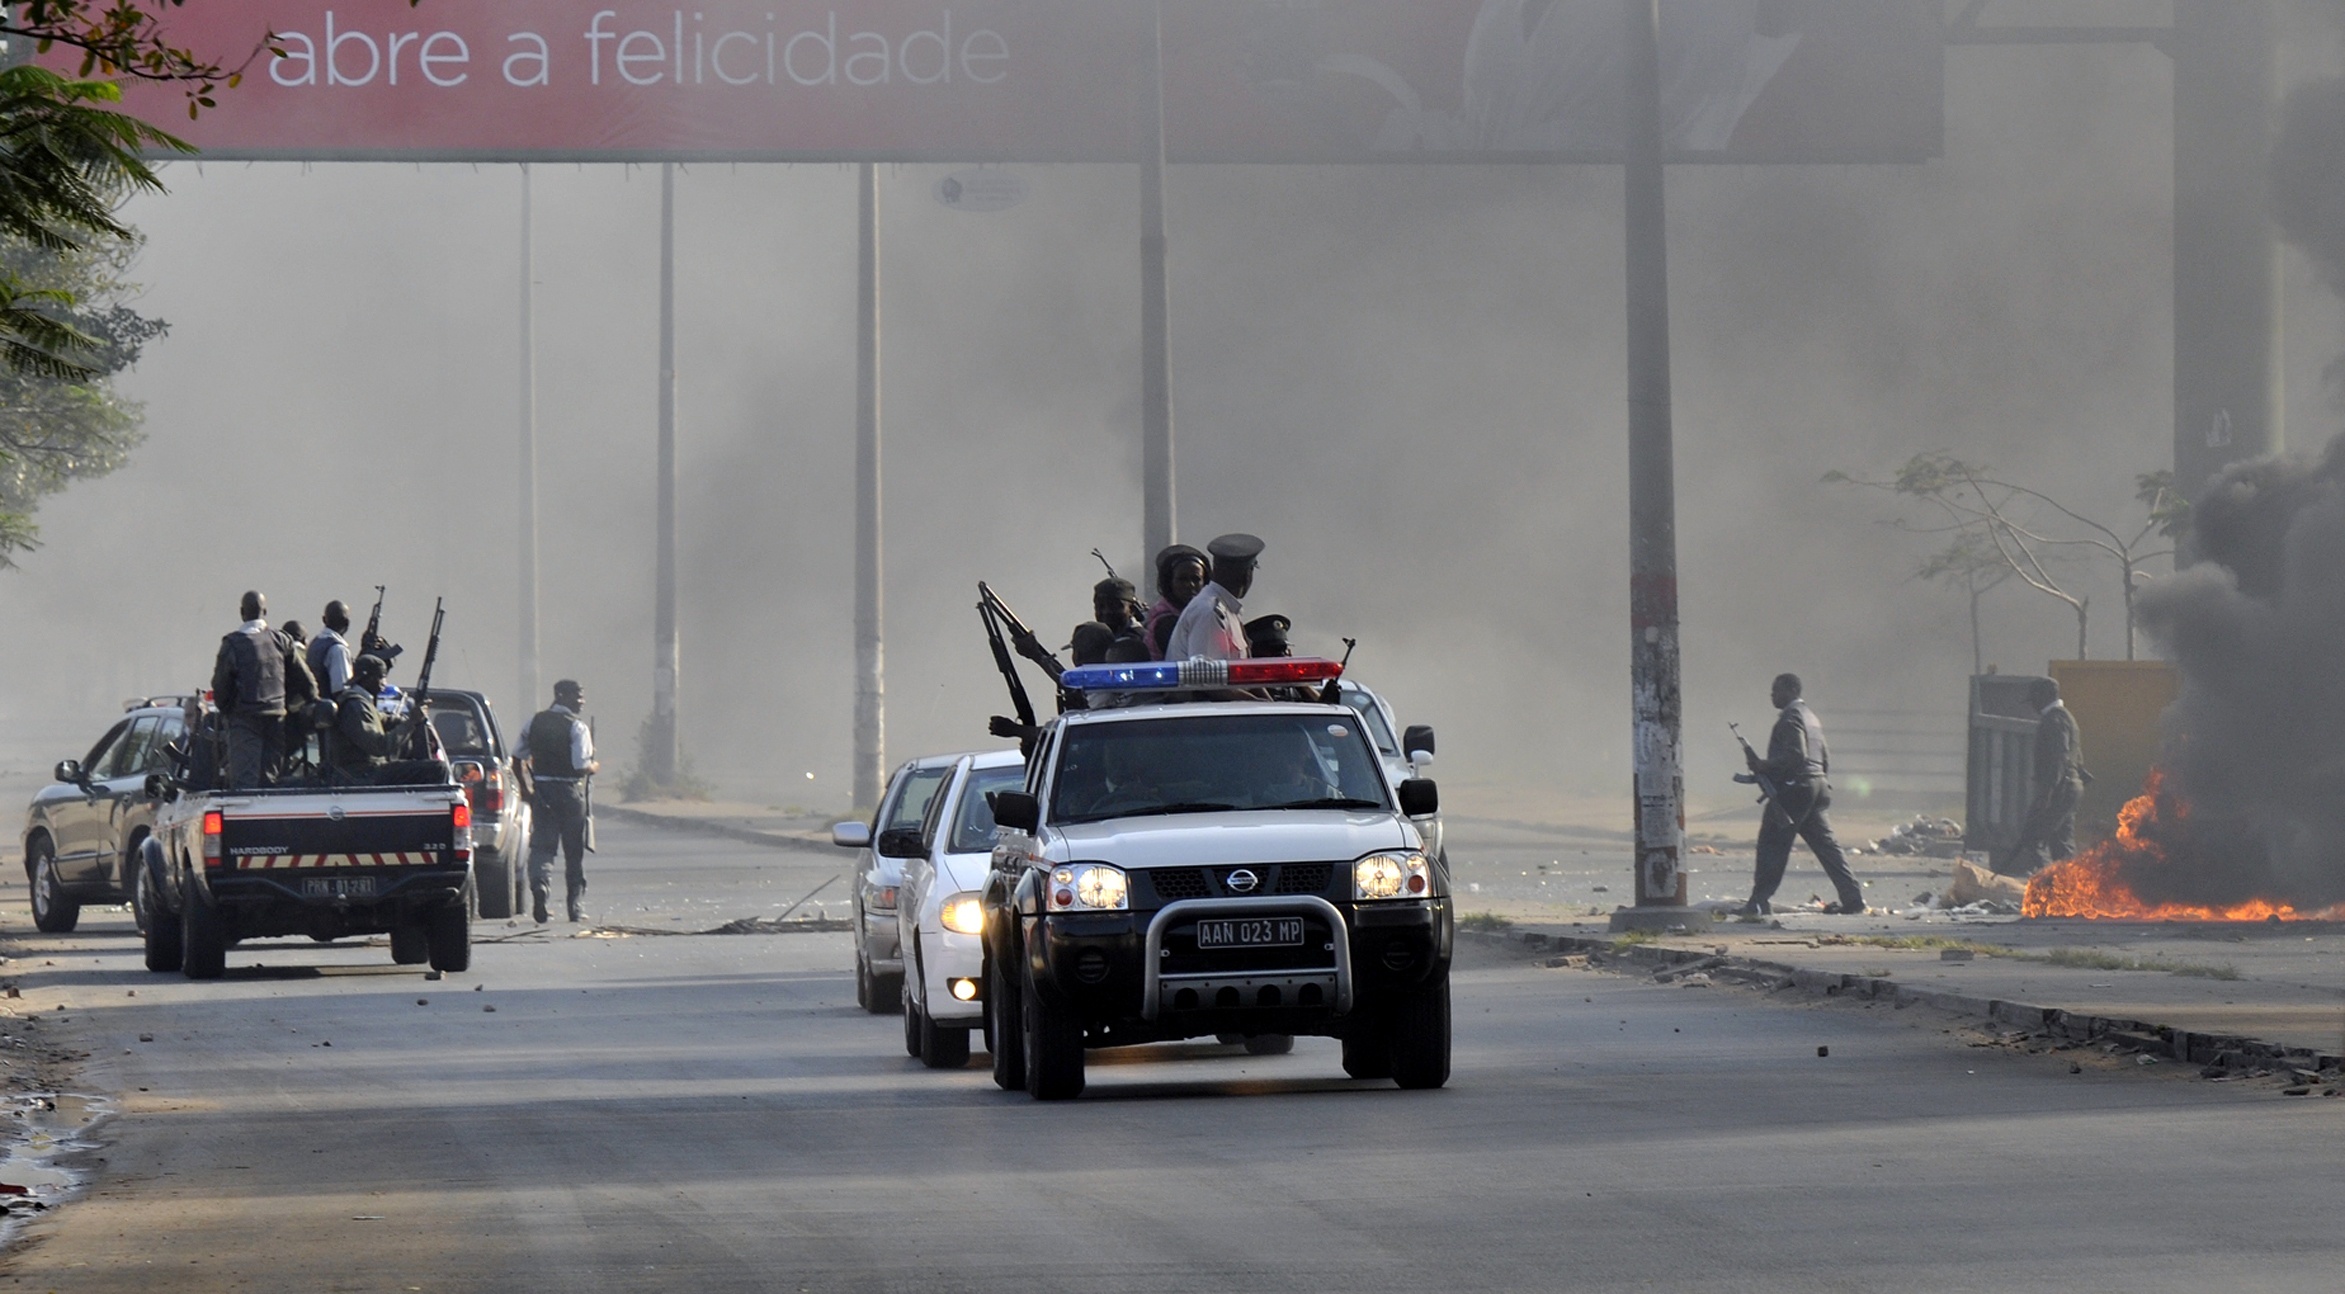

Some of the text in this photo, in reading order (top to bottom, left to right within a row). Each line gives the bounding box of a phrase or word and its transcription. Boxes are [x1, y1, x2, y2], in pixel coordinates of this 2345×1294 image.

[269, 9, 1010, 87] abre a felicidade
[1202, 921, 1300, 944] AAN 023 MP
